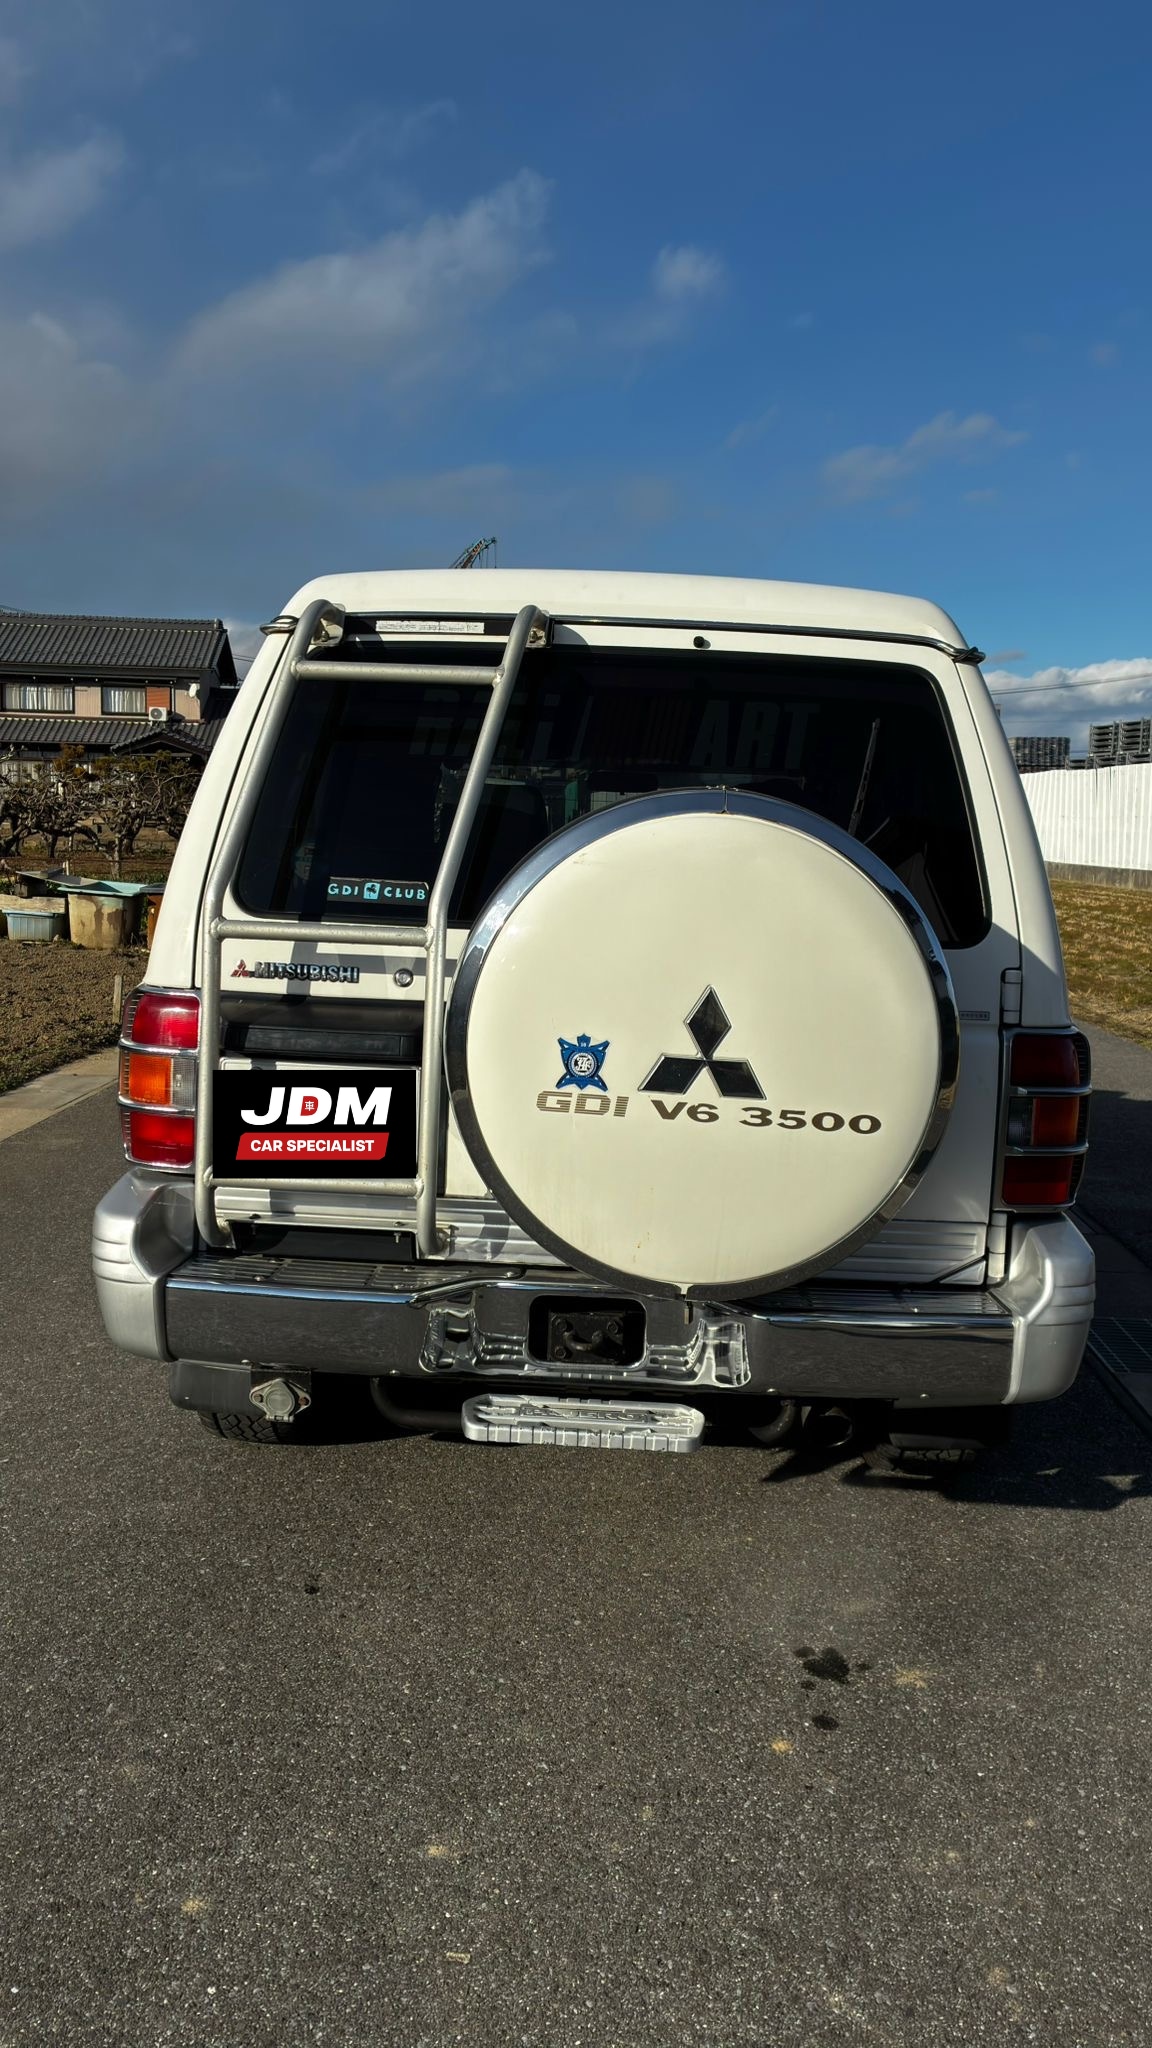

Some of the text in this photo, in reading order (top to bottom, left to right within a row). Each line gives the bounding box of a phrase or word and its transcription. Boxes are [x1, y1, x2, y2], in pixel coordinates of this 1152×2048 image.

[328, 883, 426, 900] GDI CLUB
[254, 961, 360, 983] MITSUBISHI
[535, 1090, 882, 1135] GDI V6 3500
